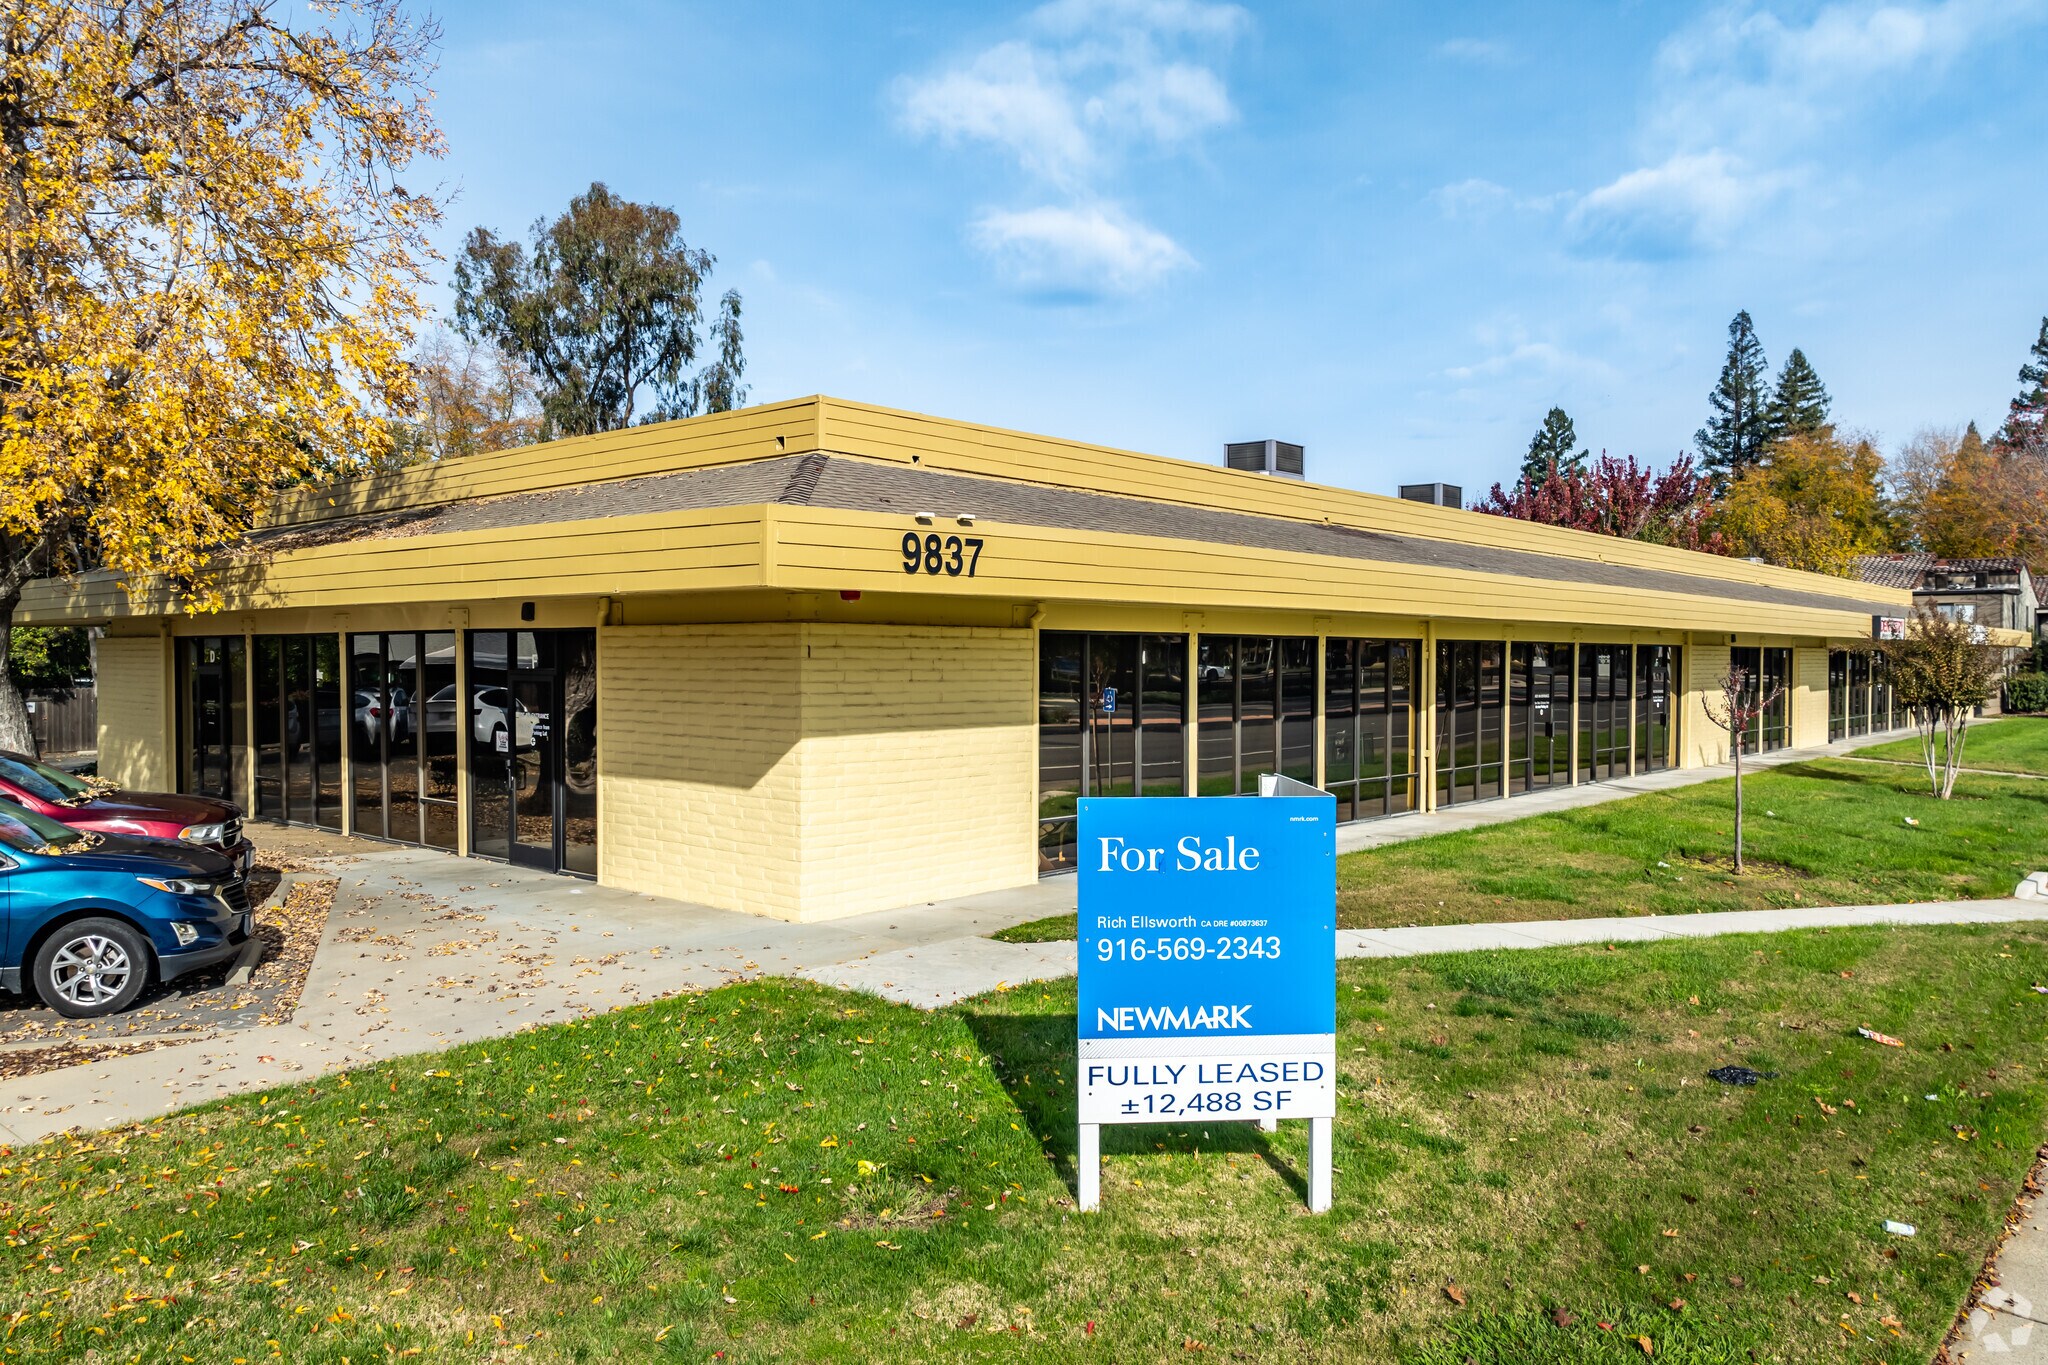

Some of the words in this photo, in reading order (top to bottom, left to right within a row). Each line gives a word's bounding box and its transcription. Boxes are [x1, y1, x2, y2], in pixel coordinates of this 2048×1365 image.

[902, 531, 984, 578] 9837
[209, 650, 215, 663] D
[1097, 837, 1164, 872] For
[1176, 836, 1260, 872] Sale
[1097, 916, 1127, 929] Rich
[1131, 916, 1197, 929] Ellsworth
[1200, 920, 1212, 928] CA
[1213, 920, 1228, 928] DRE
[1097, 936, 1281, 962] 916-569-2343
[1097, 1005, 1253, 1032] NEWMARK
[1088, 1064, 1187, 1087] FULLY
[1198, 1062, 1324, 1084] LEASED
[1121, 1092, 1242, 1116] ±12,488
[1253, 1091, 1292, 1111] SF
